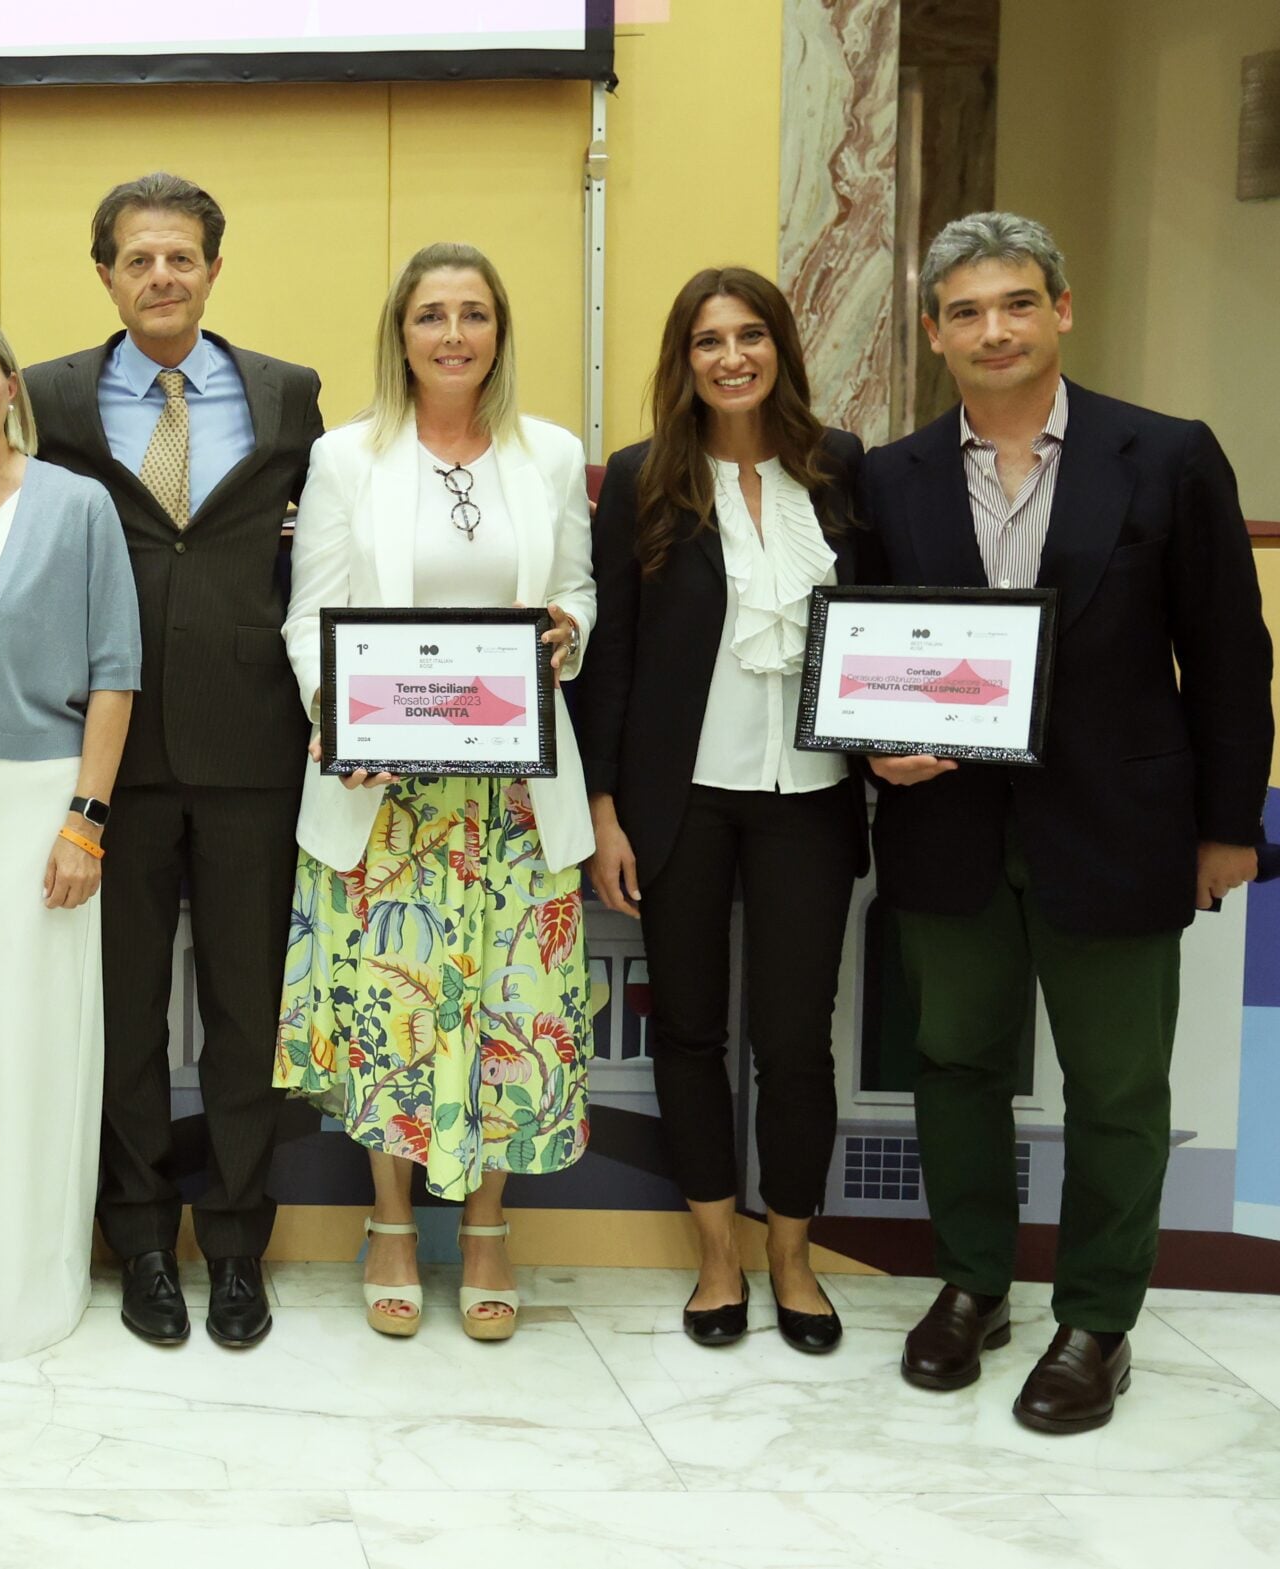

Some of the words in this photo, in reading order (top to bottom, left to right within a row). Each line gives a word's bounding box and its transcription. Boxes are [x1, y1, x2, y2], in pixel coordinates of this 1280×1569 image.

[850, 627, 865, 637] 2°
[356, 644, 369, 655] 1°
[906, 668, 942, 677] Cortalto
[395, 683, 427, 694] Terre
[428, 683, 479, 694] Siciliane
[867, 682, 901, 691] TENUTA
[902, 684, 937, 693] CERULLI
[938, 685, 981, 695] SPINOZZI
[982, 679, 1004, 688] 2023
[393, 696, 430, 706] Rosato
[431, 696, 449, 706] IGT
[452, 696, 482, 706] 2023
[405, 707, 469, 718] BONAVITA
